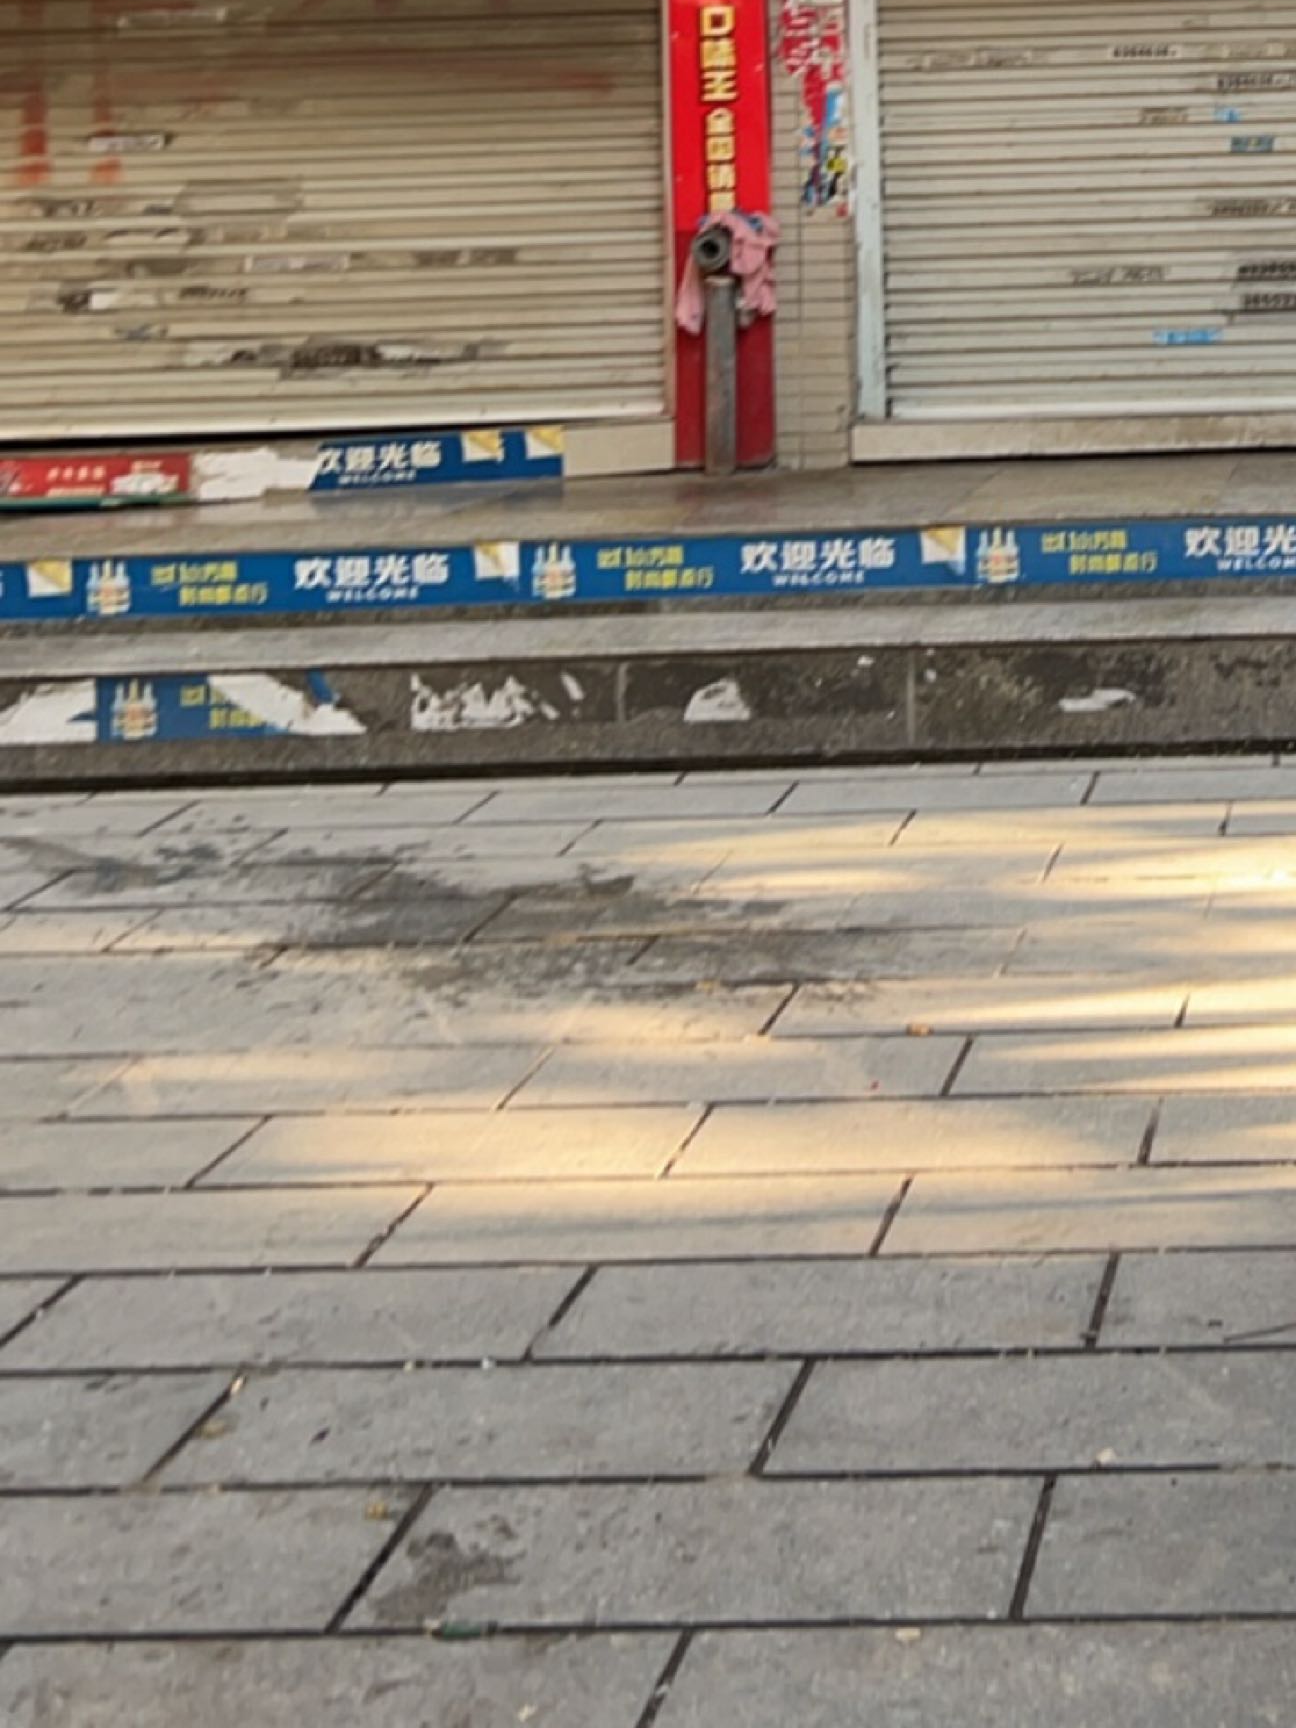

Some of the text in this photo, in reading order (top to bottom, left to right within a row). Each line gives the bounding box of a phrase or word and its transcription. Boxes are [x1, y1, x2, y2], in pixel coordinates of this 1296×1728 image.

[315, 440, 442, 475] 欢迎光临
[294, 552, 449, 589] 欢迎光临
[741, 536, 896, 573] 欢迎光临
